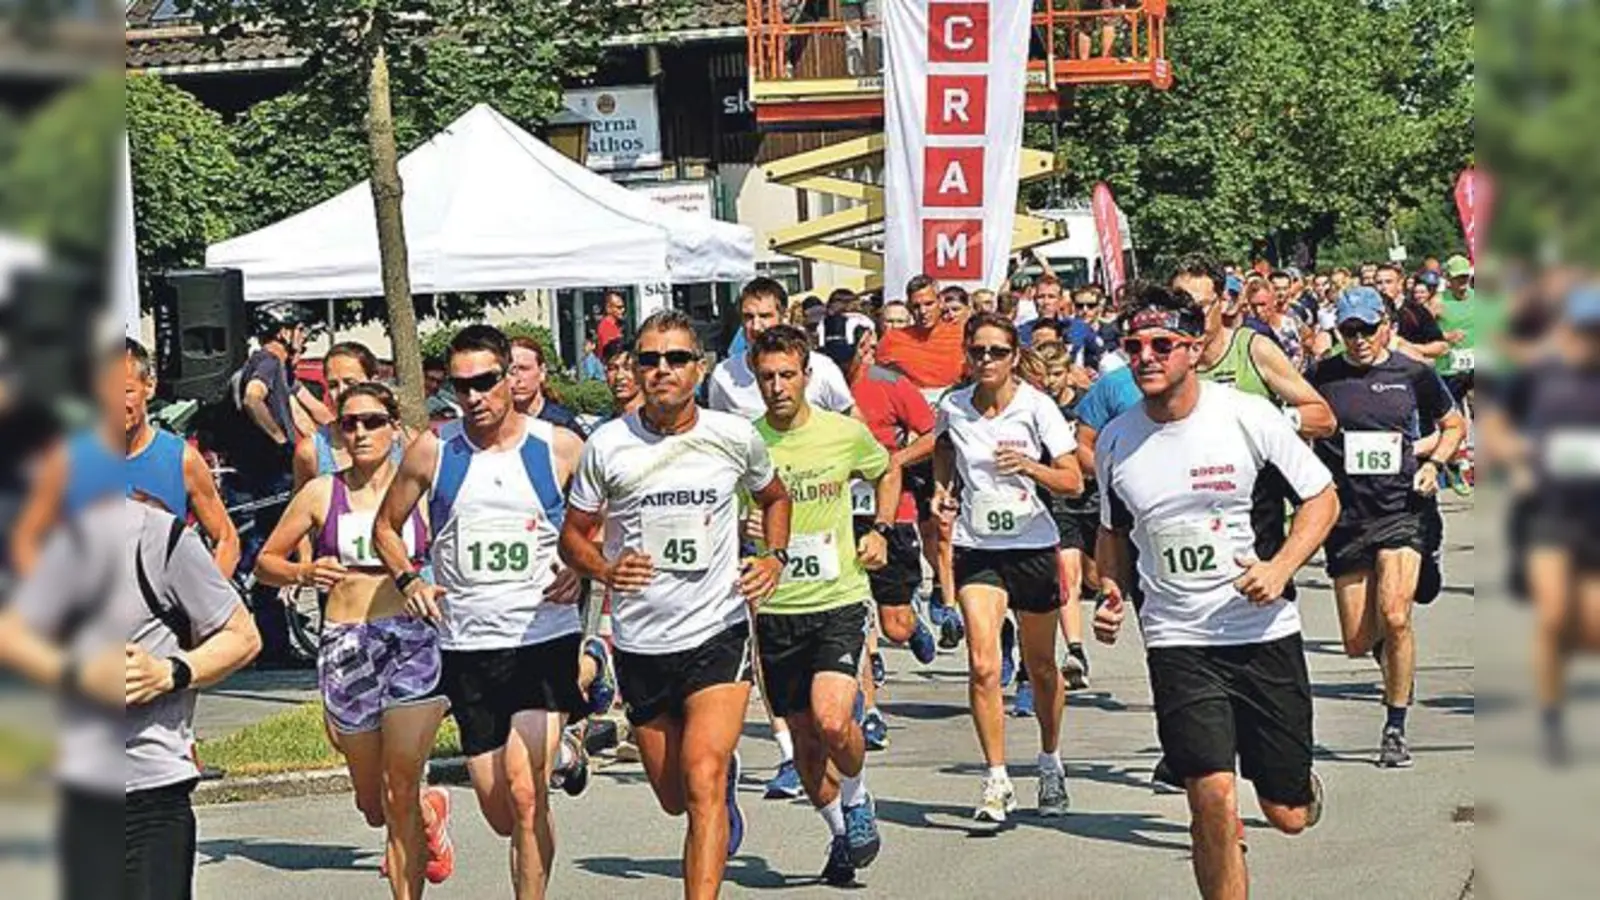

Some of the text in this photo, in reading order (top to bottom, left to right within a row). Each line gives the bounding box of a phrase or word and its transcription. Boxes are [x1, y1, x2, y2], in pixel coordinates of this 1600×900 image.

[936, 16, 974, 268] CRAM
[1355, 449, 1392, 470] 163
[640, 488, 718, 508] AIRBUS
[986, 509, 1015, 531] 98
[467, 540, 529, 572] 139
[663, 537, 698, 564] 45
[1162, 544, 1217, 574] 102
[789, 555, 820, 578] 26
